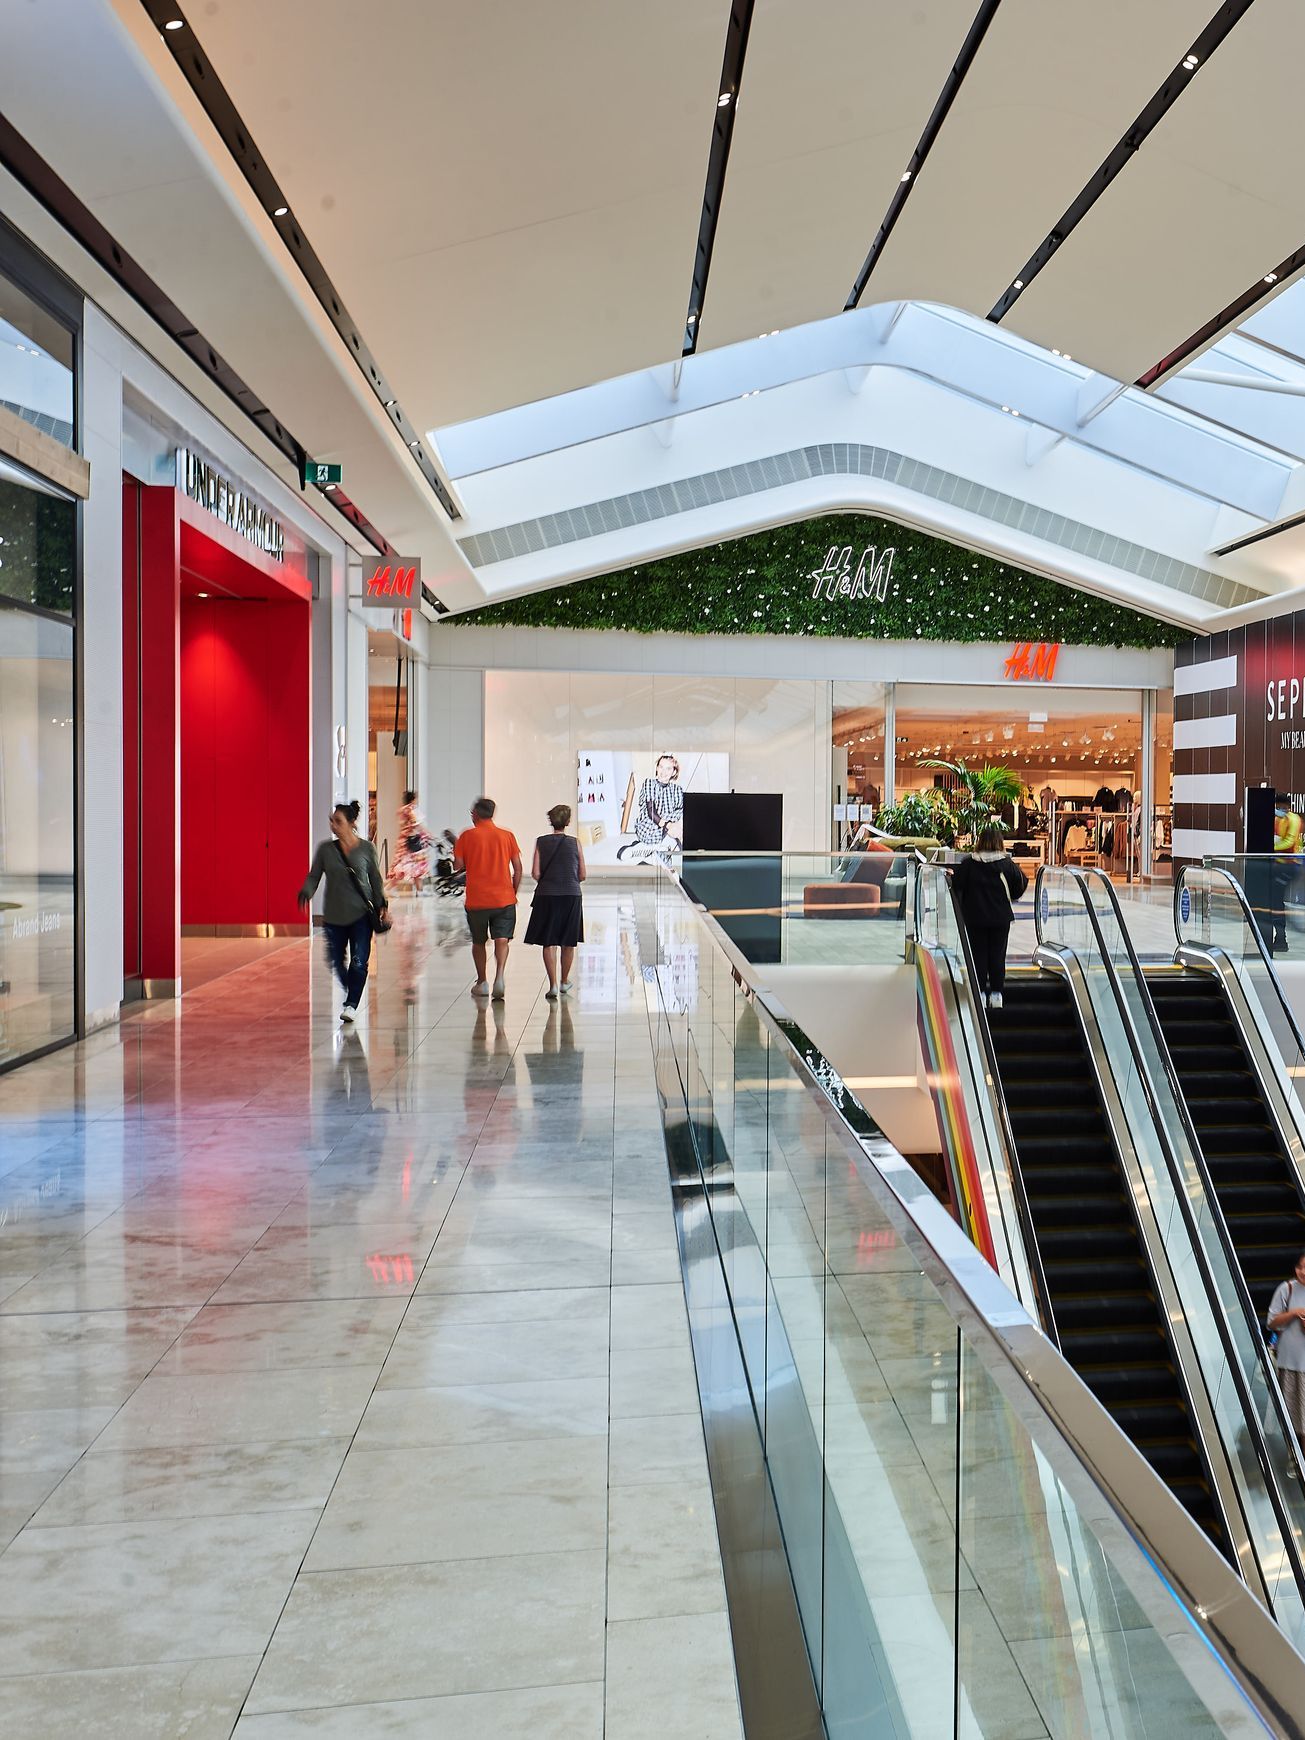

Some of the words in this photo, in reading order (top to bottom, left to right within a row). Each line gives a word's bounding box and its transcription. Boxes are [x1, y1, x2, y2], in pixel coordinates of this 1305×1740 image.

[184, 447, 235, 528] UNDER
[233, 491, 284, 563] ARMOUR
[367, 565, 416, 599] H&M
[812, 545, 895, 602] H&M
[1004, 642, 1059, 681] H&M
[1280, 731, 1291, 750] MY
[13, 912, 39, 939] Abrand
[40, 911, 60, 933] Jeans
